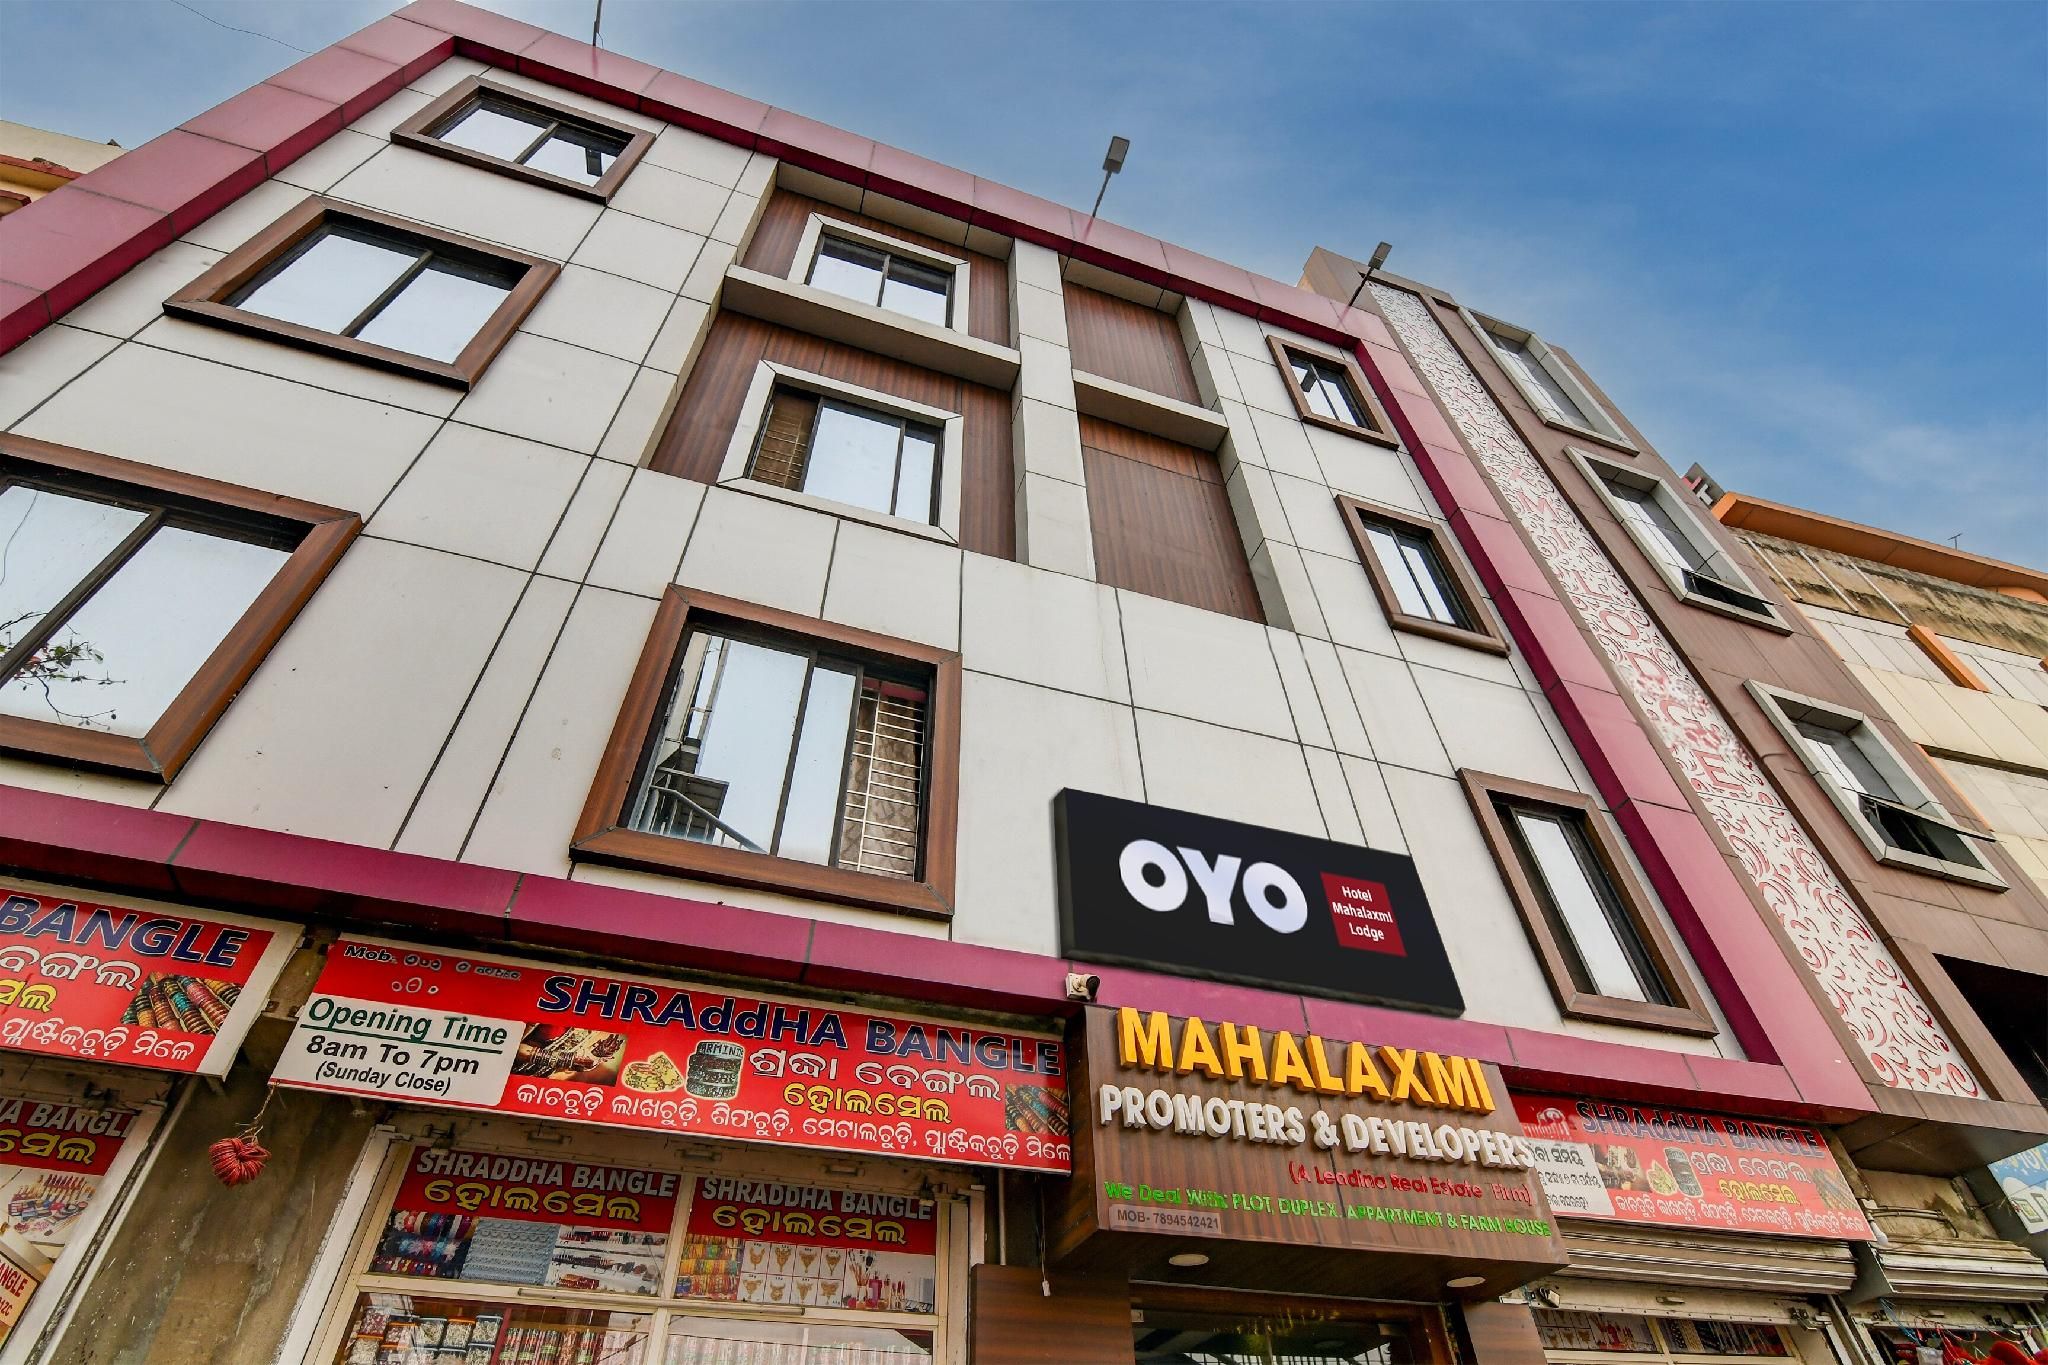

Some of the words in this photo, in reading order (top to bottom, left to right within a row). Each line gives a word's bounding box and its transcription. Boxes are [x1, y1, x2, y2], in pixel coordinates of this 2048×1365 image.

[1118, 838, 1308, 933] OYO
[1342, 886, 1373, 902] Hotel
[0, 894, 250, 967] BANGLE
[1332, 902, 1393, 924] Mahalaxmi
[1348, 922, 1385, 942] Lodge
[308, 998, 433, 1041] Opening
[444, 1016, 508, 1045] Time
[306, 1035, 368, 1060] 8am
[379, 1043, 410, 1066] To
[421, 1049, 480, 1075] 7pm
[865, 1019, 1061, 1076] BANGLE
[1117, 1006, 1496, 1115] MAHALAXMI
[315, 1060, 391, 1089] (Sunday
[395, 1071, 451, 1096] Close)
[783, 1082, 952, 1123] ହୋଲସେଲ
[1100, 1083, 1306, 1146] PROMOTERS
[1309, 1109, 1340, 1149] &
[1341, 1114, 1536, 1171] DEVELOPERS
[1722, 1119, 1826, 1158] BANGLE
[416, 1150, 563, 1186] SHRADDHA
[572, 1165, 676, 1198] BANGLE
[1289, 1161, 1311, 1185] (A
[1390, 1172, 1428, 1194] Real
[1429, 1176, 1483, 1199] Estate
[702, 1177, 833, 1212] SHRADDHA
[841, 1189, 934, 1220] BANGLE
[1104, 1182, 1132, 1200] We
[1138, 1184, 1182, 1204] Deal
[1347, 1204, 1443, 1227] APPARTMENT
[1446, 1213, 1458, 1229] &
[1459, 1214, 1502, 1233] FARM
[1503, 1217, 1552, 1237] HOUSE
[1153, 1213, 1219, 1230] 7894542421
